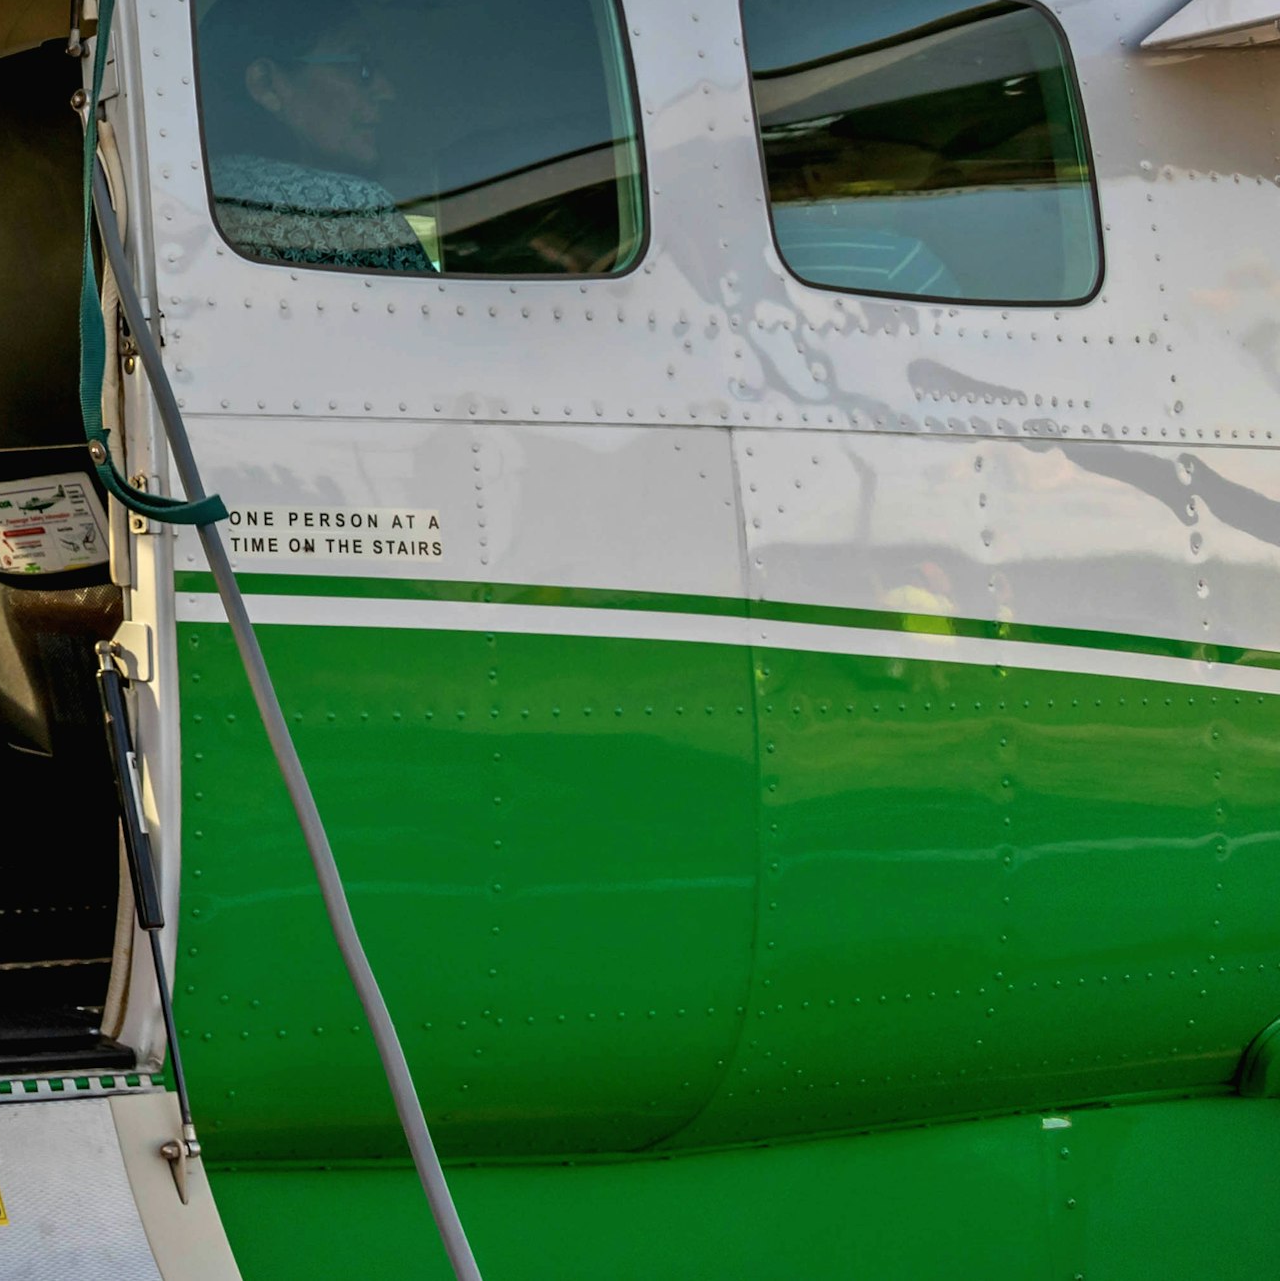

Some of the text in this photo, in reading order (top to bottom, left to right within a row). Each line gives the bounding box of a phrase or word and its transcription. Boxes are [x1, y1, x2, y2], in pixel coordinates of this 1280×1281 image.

[229, 511, 440, 529] ONE PERSON AT A
[231, 538, 442, 556] TIME ON THE STAIRS
